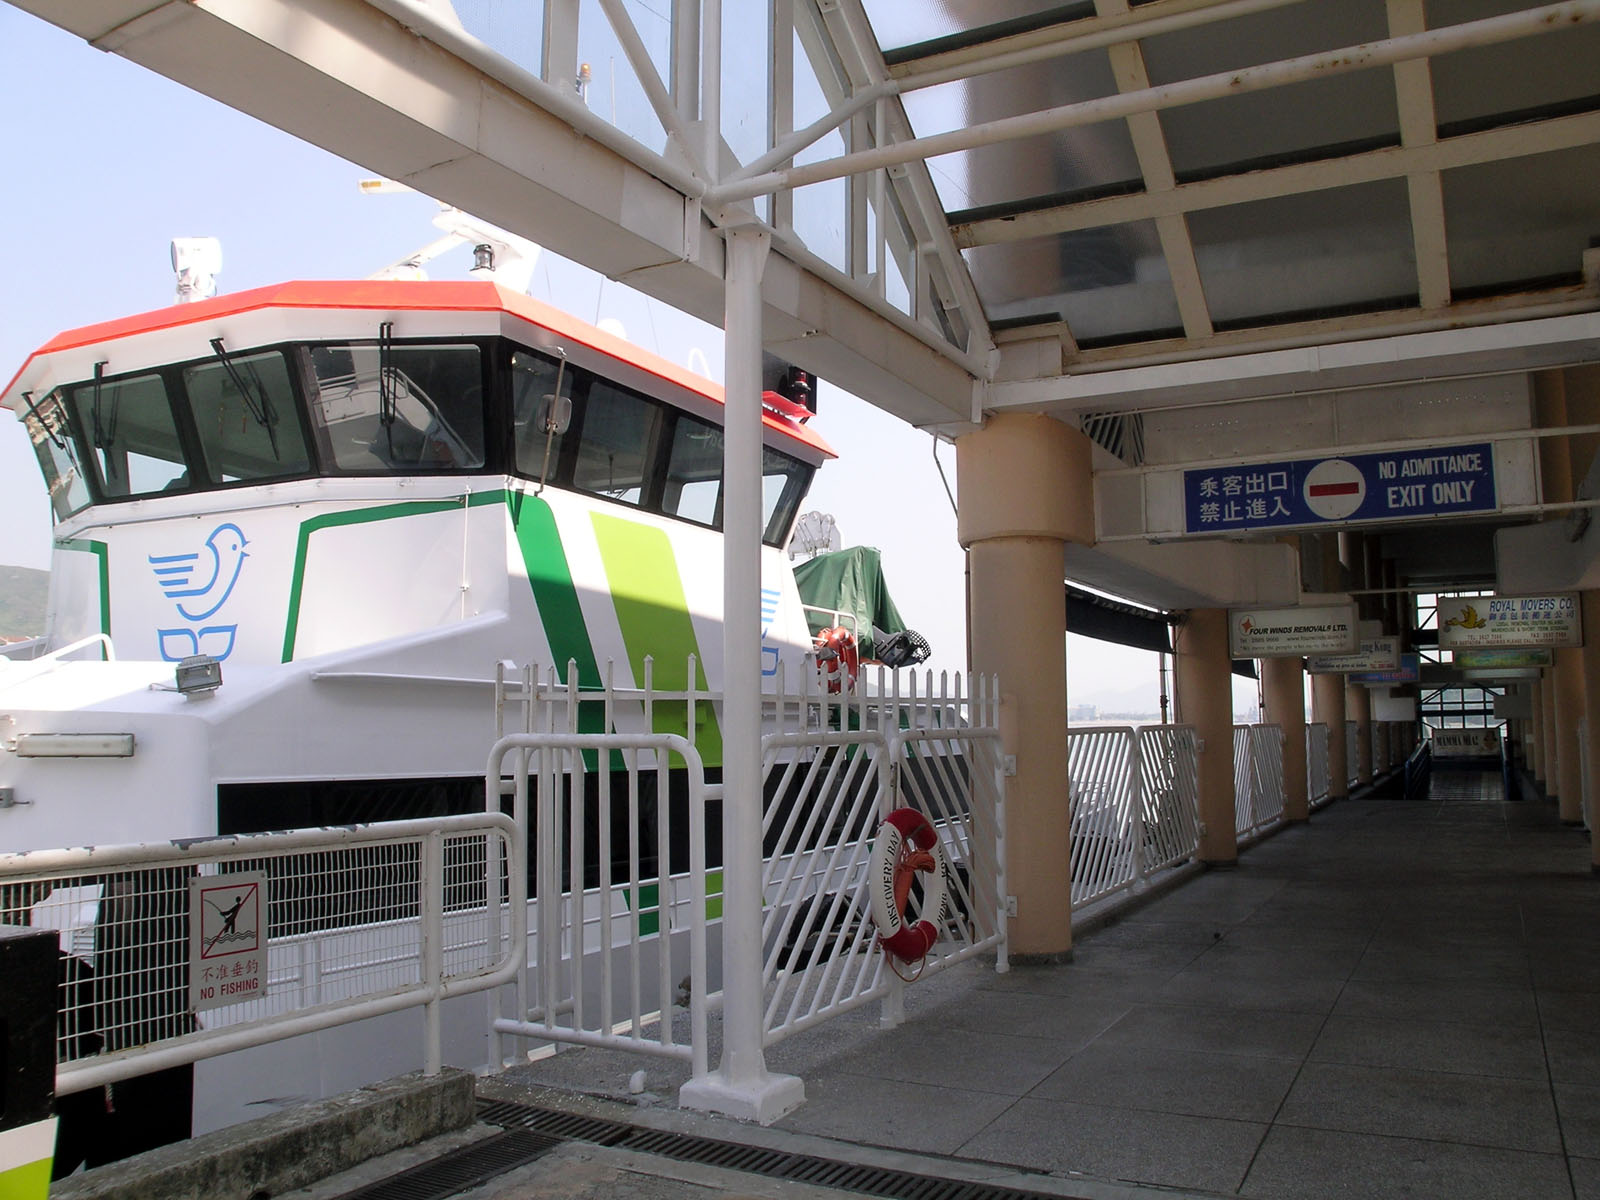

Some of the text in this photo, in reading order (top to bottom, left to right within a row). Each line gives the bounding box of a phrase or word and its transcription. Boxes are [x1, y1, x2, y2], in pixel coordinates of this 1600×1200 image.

[1378, 453, 1483, 479] NO ADMITTANCE
[1200, 472, 1288, 497] 乘客出口
[1387, 480, 1475, 508] EXIT ONLY
[1200, 496, 1291, 523] 禁止進入
[1489, 598, 1574, 612] ROYAL MOVERS CO.
[1249, 624, 1348, 635] FOUR WINDS REMOVALS LTD.
[883, 831, 900, 928] DISCOVERY BAY
[201, 959, 259, 983] 不准垂釣
[200, 986, 214, 1000] NO
[220, 978, 259, 996] FISHING
